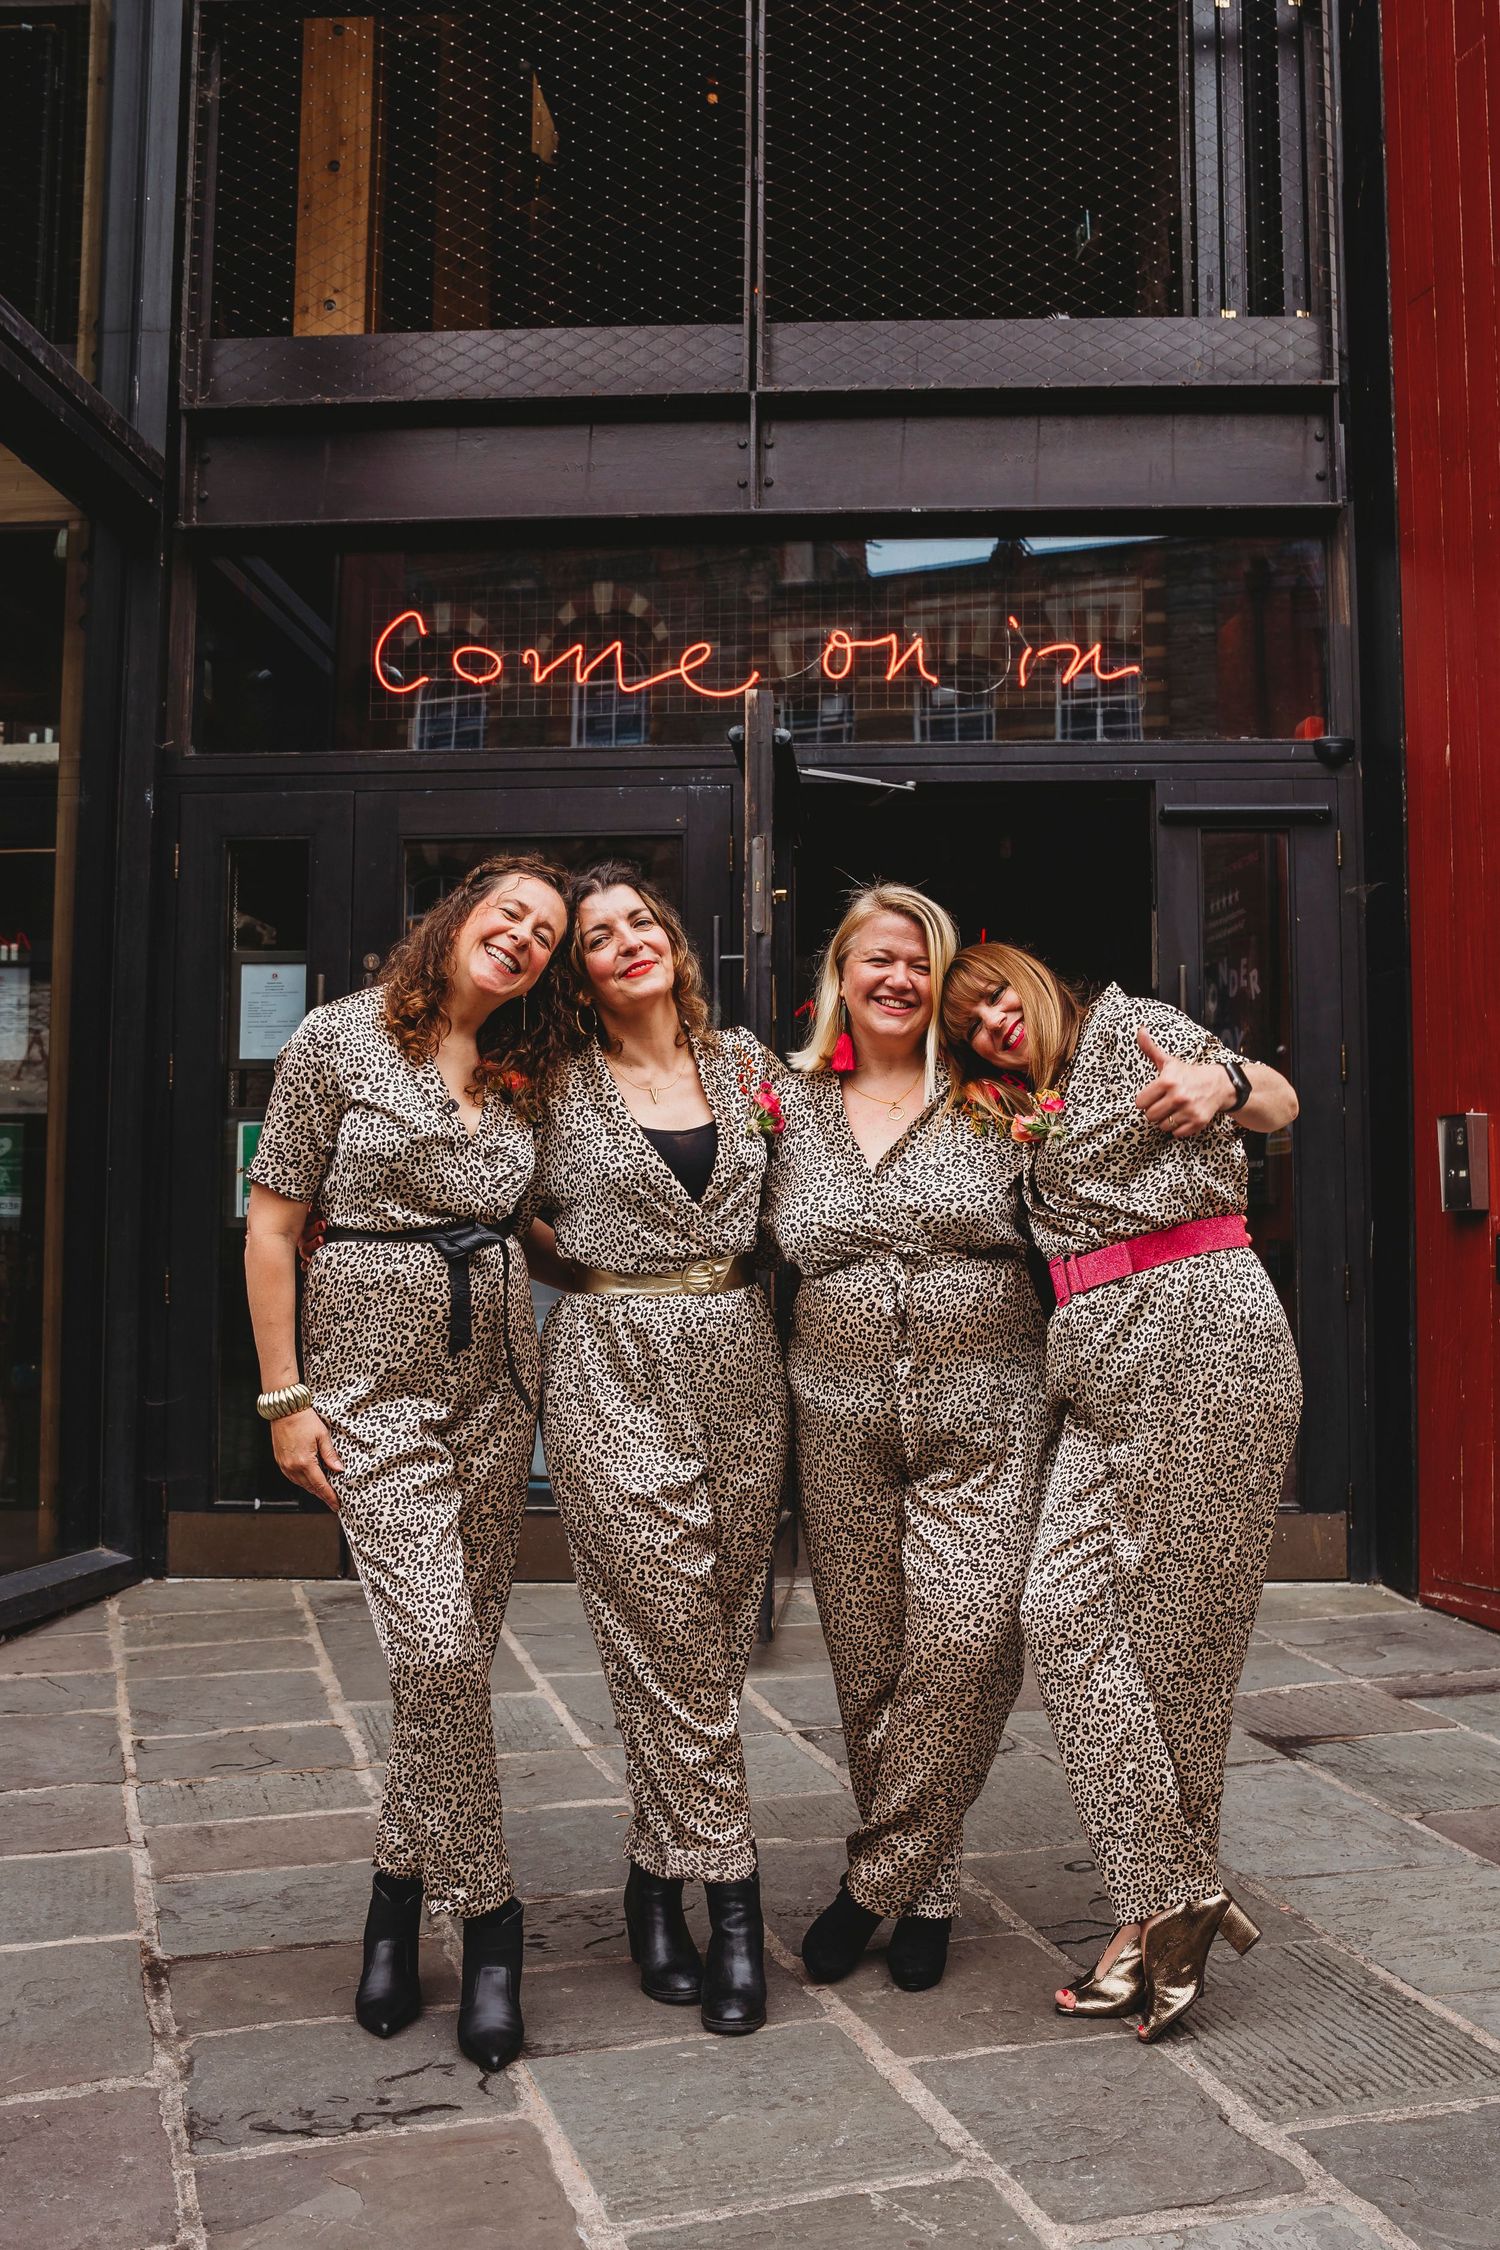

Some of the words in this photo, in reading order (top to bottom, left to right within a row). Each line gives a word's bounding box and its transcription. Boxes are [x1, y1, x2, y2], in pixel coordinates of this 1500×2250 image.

[374, 609, 760, 699] Come
[821, 628, 939, 687] on
[1008, 615, 1141, 688] in
[1205, 957, 1261, 1013] ONDER
